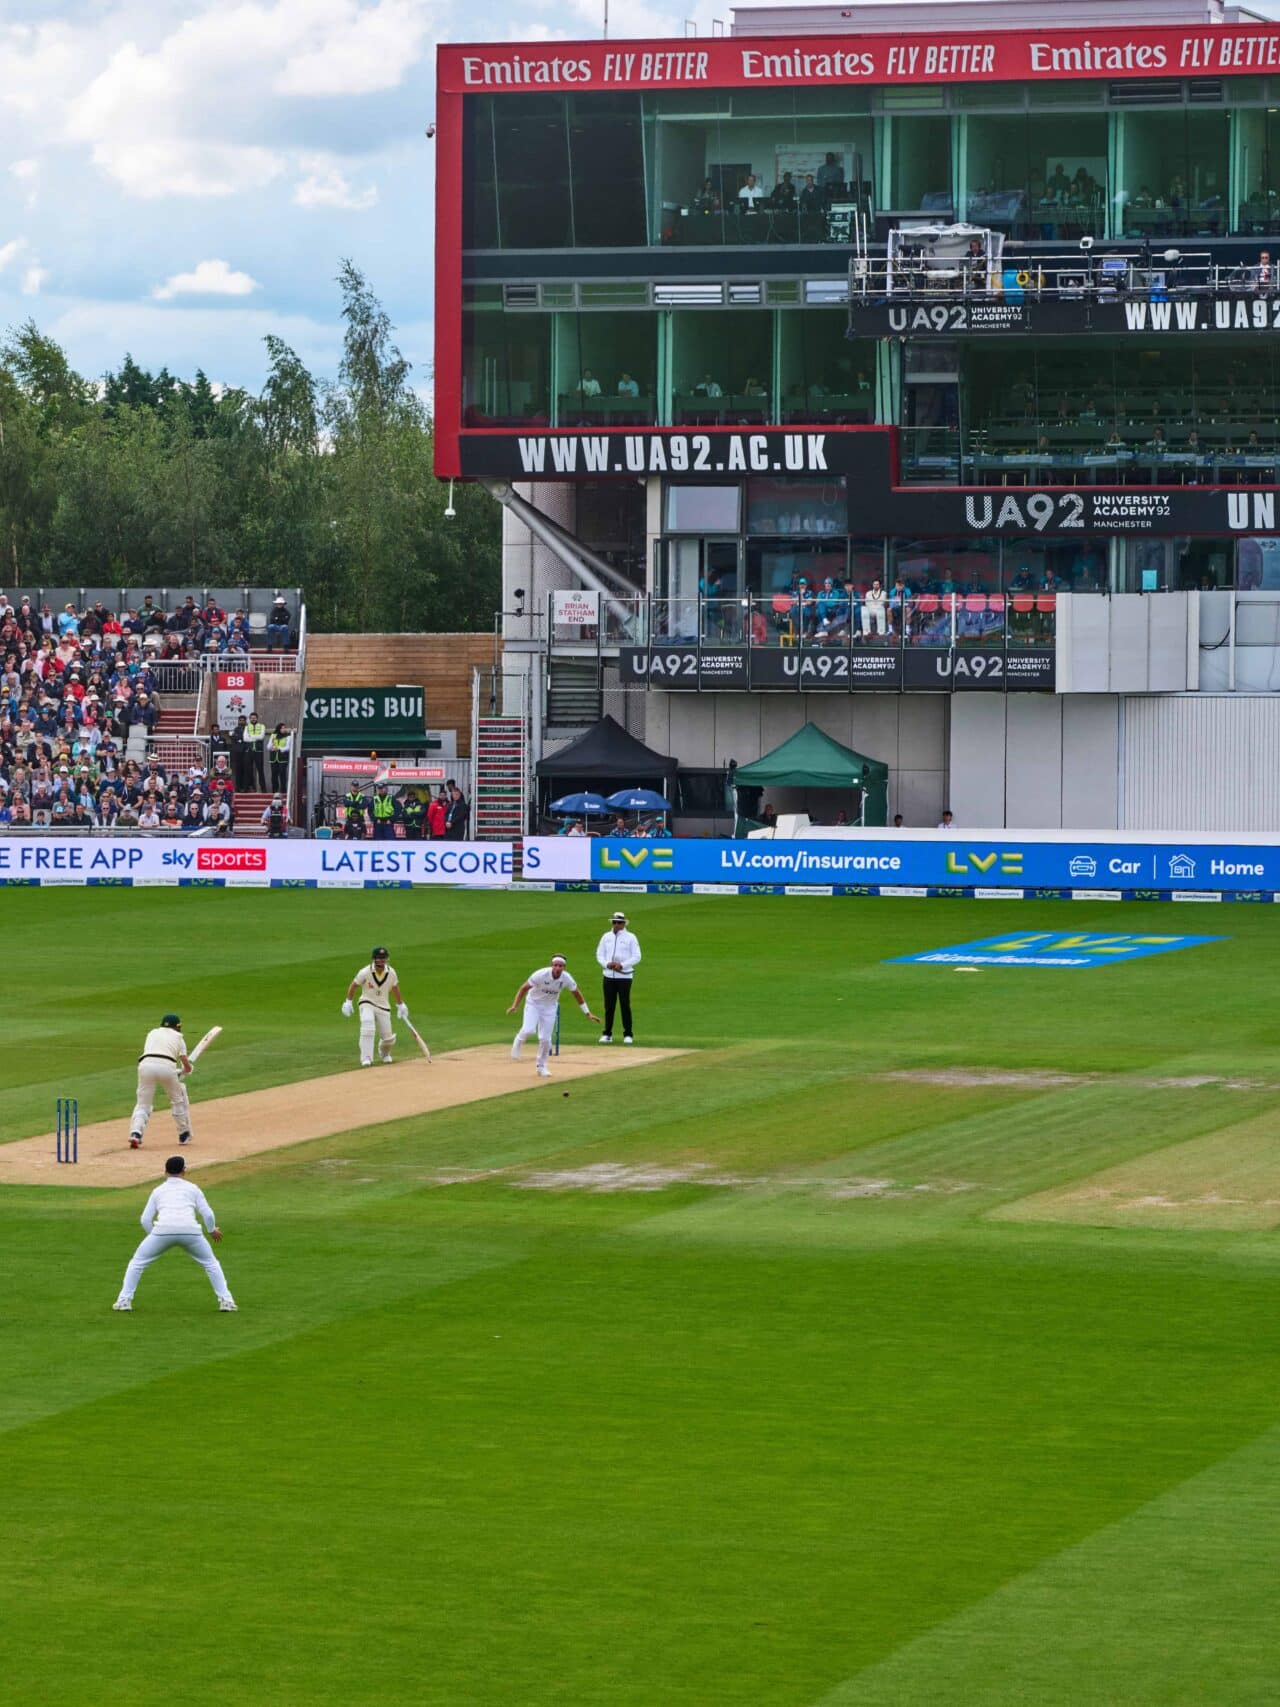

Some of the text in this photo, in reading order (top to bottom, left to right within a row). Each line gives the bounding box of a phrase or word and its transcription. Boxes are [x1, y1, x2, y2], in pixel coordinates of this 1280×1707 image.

[742, 44, 995, 79] Emirates FLY BETTER
[1029, 36, 1280, 71] Emirates FLY BETTE
[462, 51, 708, 84] Emirates FLY BETTER
[888, 305, 968, 331] UA92
[518, 434, 829, 473] WWW.UA92.AC.UK
[1093, 495, 1170, 505] UNIVERSITY
[1093, 506, 1171, 516] ACADEMY92
[1227, 492, 1276, 530] UN
[964, 493, 1085, 532] UA92
[632, 654, 697, 676] UA92
[783, 655, 849, 678] UA92
[936, 656, 1003, 678] UA92
[227, 676, 245, 686] B8
[21, 847, 83, 868] FREE
[90, 848, 143, 869] APP
[162, 849, 263, 868] sky sports
[322, 850, 416, 872] LATEST
[720, 850, 901, 872] LV.com/insurance
[1108, 858, 1140, 874] Car
[1210, 860, 1265, 875] Home
